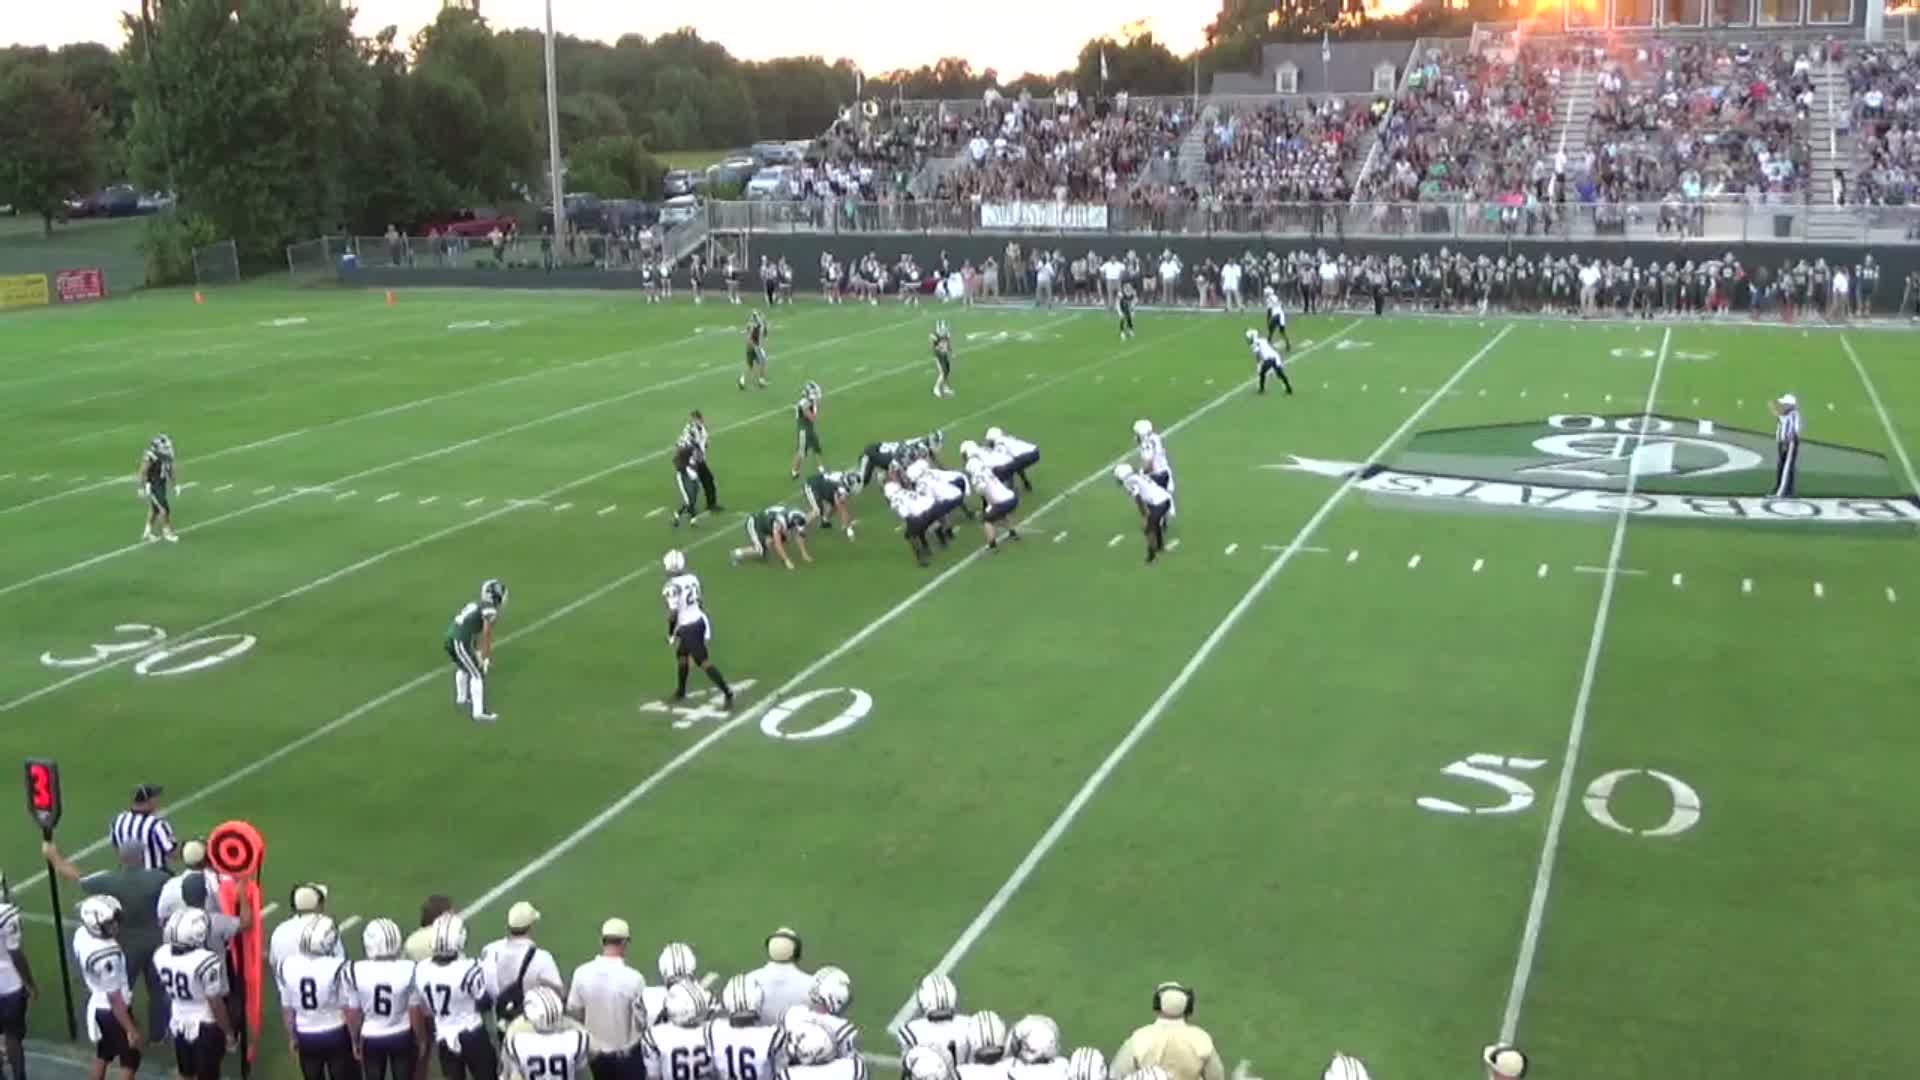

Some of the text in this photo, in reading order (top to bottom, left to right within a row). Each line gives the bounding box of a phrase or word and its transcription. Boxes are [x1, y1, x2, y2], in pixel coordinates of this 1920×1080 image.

[1376, 473, 1909, 519] BOBCATS
[40, 623, 257, 676] 30
[29, 763, 51, 809] 3
[1416, 753, 1701, 836] 50
[160, 967, 194, 1001] 28
[300, 976, 318, 1010] 8
[373, 984, 393, 1016] 6
[424, 981, 452, 1017] 17
[527, 1054, 568, 1080] 29
[672, 1045, 711, 1080] 62
[725, 1045, 758, 1080] 16
